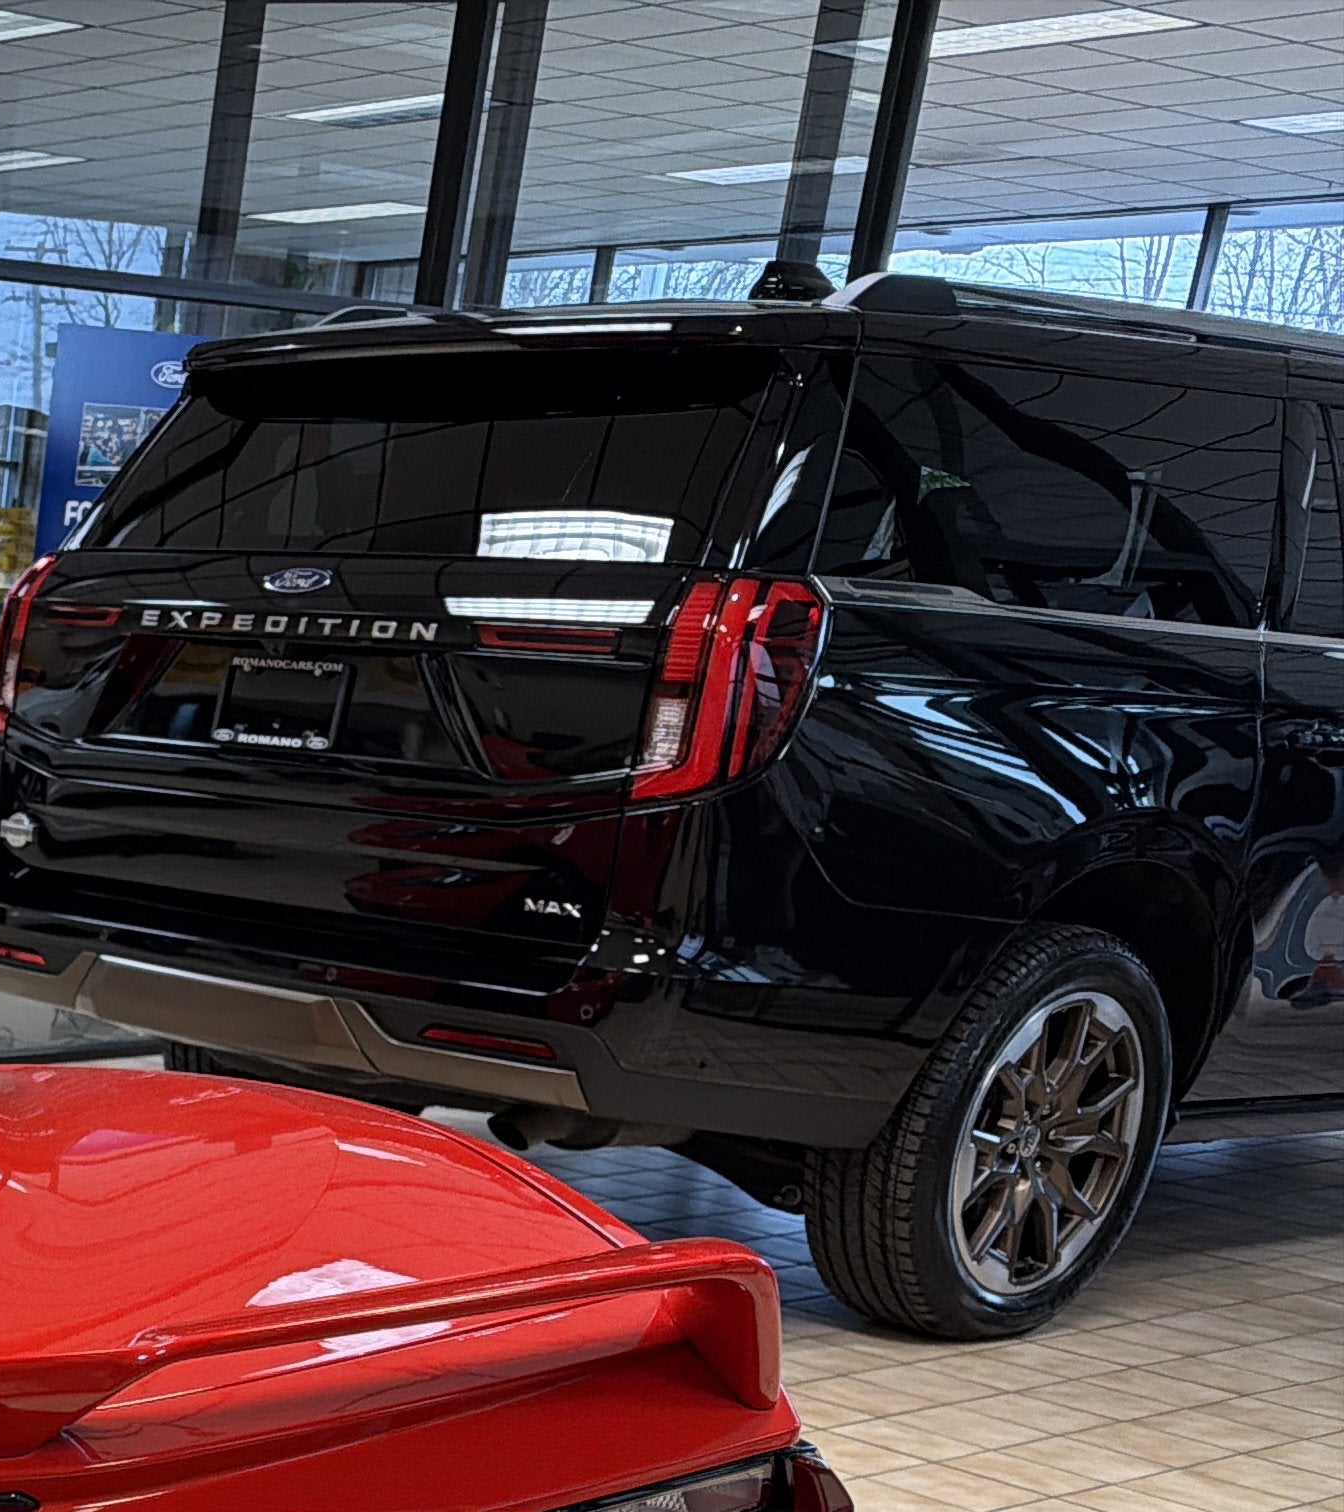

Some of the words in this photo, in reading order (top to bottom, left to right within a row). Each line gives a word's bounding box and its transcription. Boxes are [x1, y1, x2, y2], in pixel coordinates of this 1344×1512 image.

[272, 569, 321, 590] Ford
[140, 609, 438, 641] EXPEDITION
[232, 657, 344, 672] ROMANOCARS.COM
[237, 733, 303, 748] ROMANO
[524, 897, 582, 918] MAX
